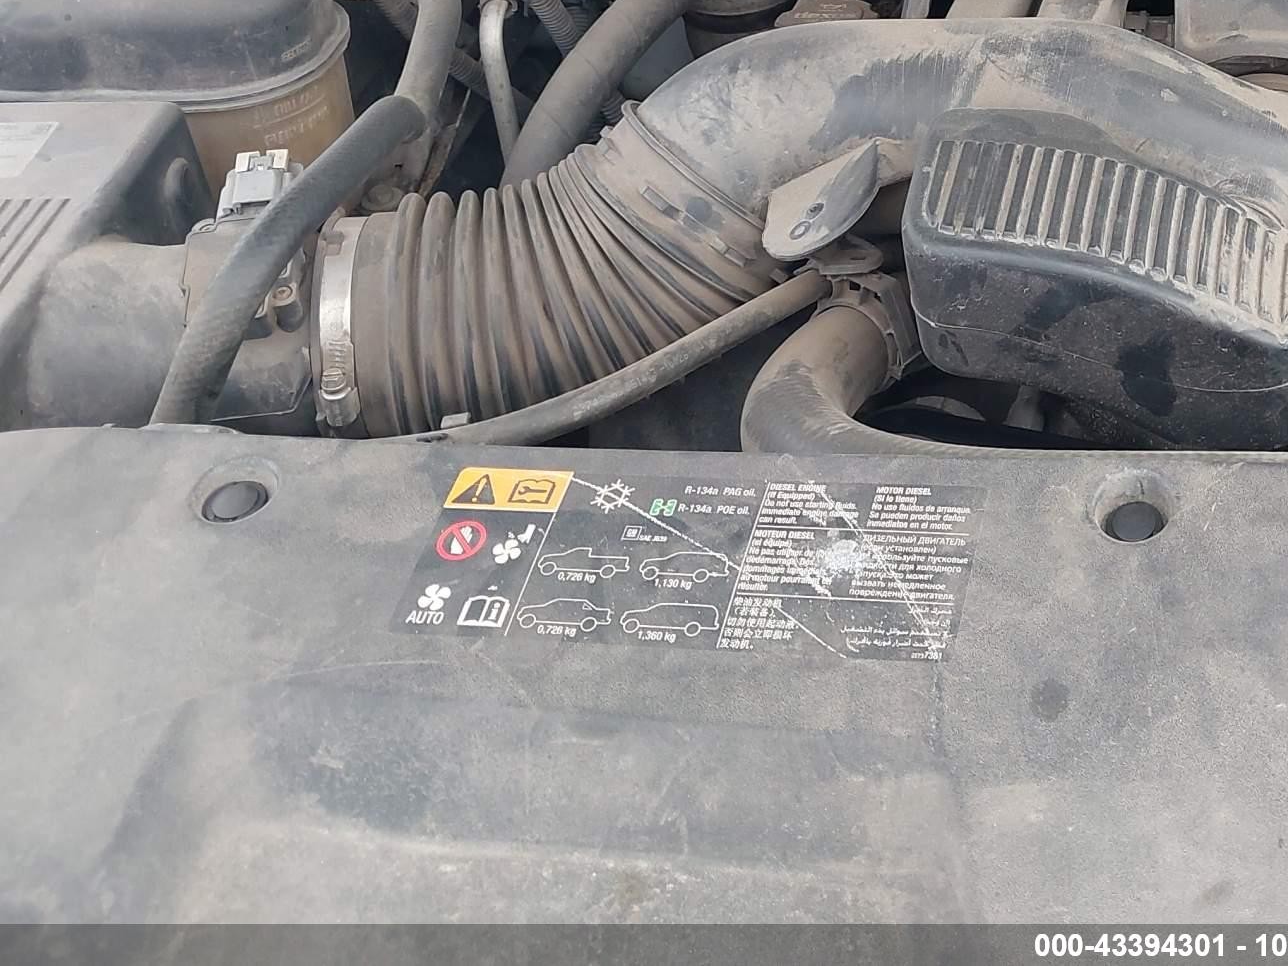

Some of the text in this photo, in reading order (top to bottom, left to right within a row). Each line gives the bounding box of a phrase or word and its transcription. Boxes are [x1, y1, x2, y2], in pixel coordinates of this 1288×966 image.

[685, 486, 757, 497] R-134a PAG oil.
[770, 483, 827, 493] DIESEL ENGINE
[678, 504, 750, 515] R-134a POE oil.
[899, 504, 923, 512] fluidos
[774, 516, 797, 524] result.
[881, 512, 908, 520] pueden
[910, 513, 941, 521] producir
[754, 530, 815, 539] MOTEUR DIESEL
[918, 536, 966, 546] ДВИГАТЕЛЬ
[928, 555, 968, 564] пусковые
[916, 564, 961, 573] холодного
[585, 573, 596, 584] kg
[680, 579, 692, 590] kg
[405, 610, 444, 625] AUTO
[564, 626, 577, 637] kg
[664, 632, 676, 643] kg
